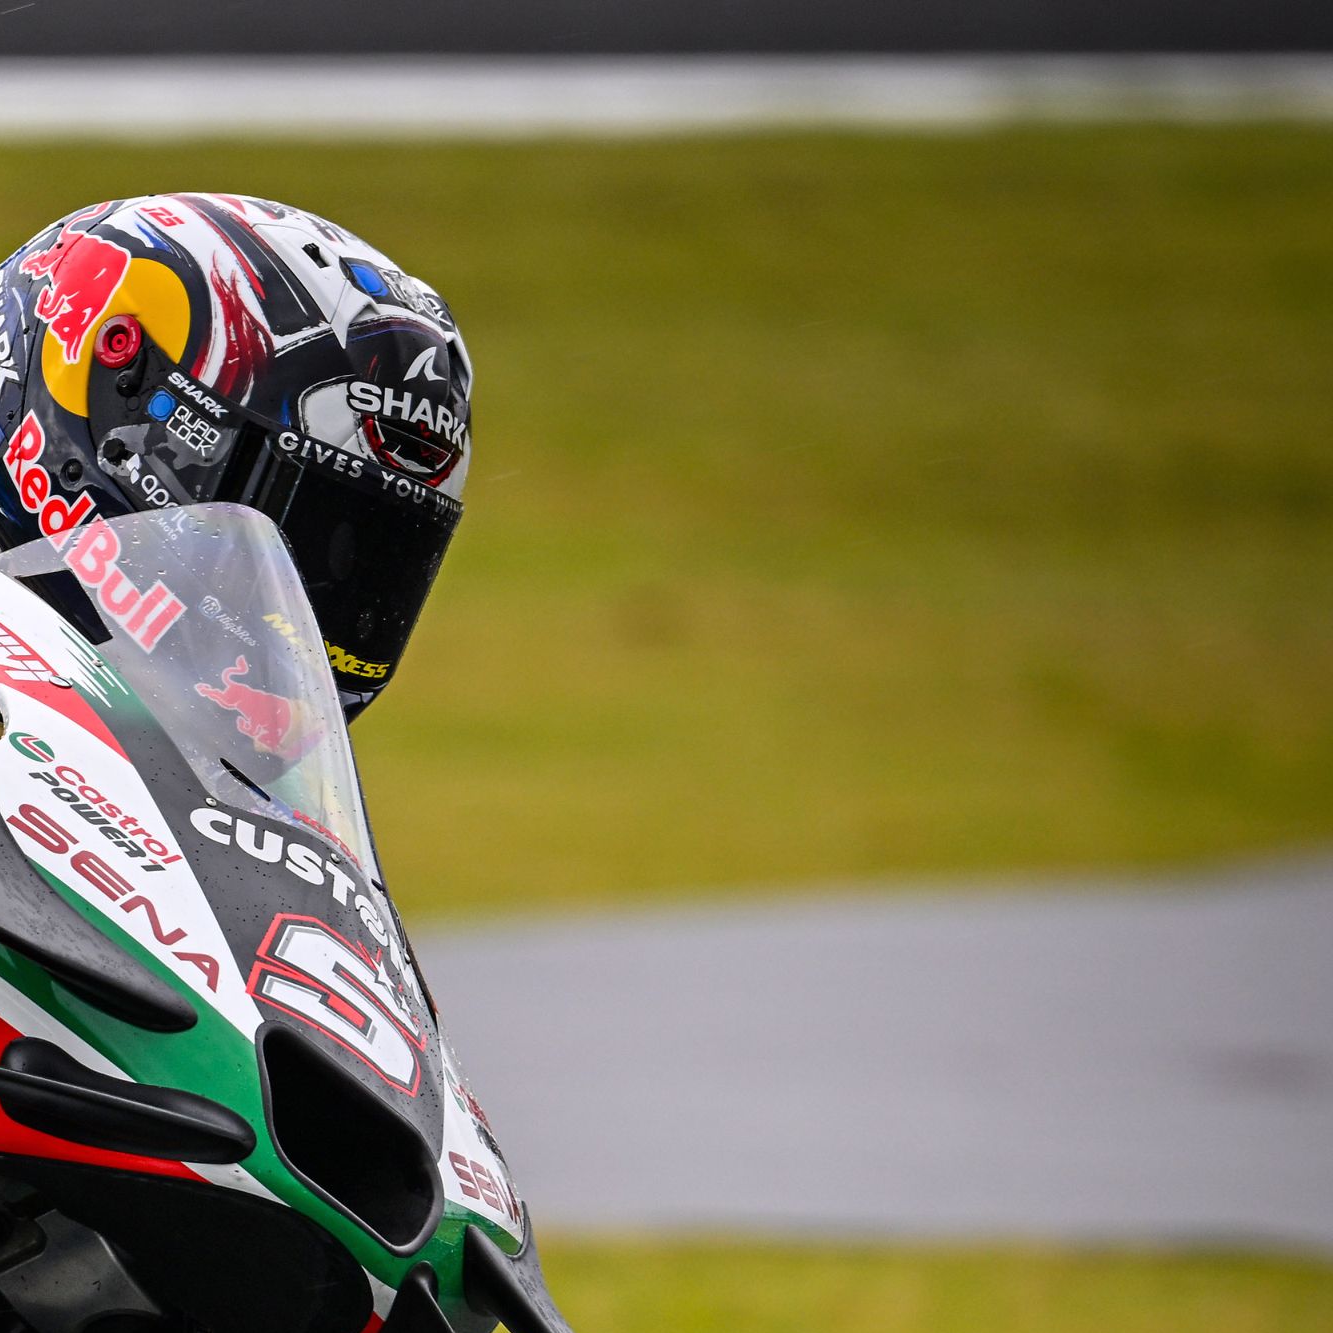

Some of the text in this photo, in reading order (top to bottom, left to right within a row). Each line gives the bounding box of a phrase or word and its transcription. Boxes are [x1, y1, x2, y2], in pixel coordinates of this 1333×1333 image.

[167, 372, 228, 418] SHARK
[174, 405, 221, 443] QUAD
[350, 381, 469, 450] SHARK
[167, 415, 213, 457] LOCK
[278, 432, 364, 478] GIVES
[382, 471, 426, 503] YOU
[3, 408, 188, 654] Red Bull
[28, 771, 166, 872] POWER1
[55, 765, 183, 866] Castrol
[6, 803, 220, 993] SENA
